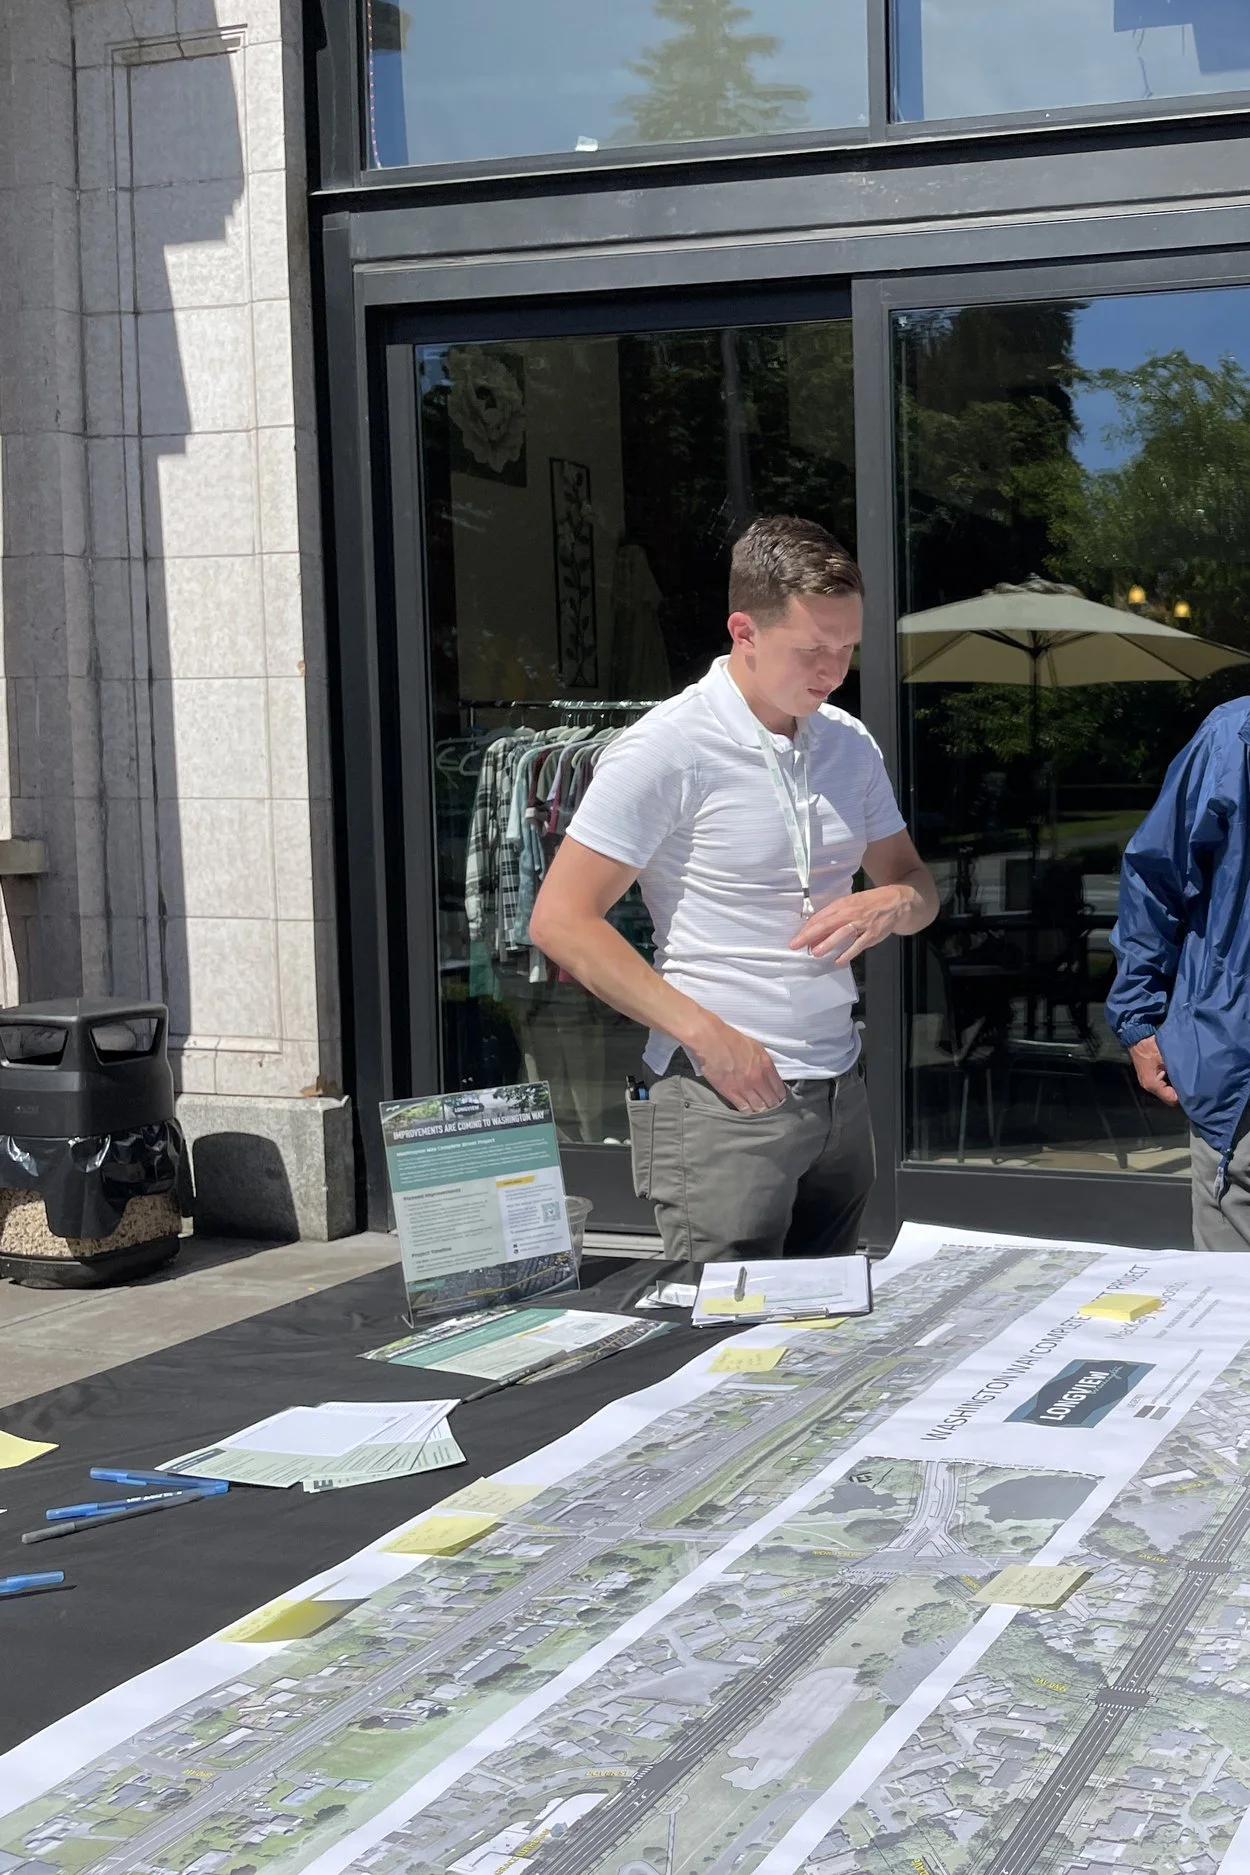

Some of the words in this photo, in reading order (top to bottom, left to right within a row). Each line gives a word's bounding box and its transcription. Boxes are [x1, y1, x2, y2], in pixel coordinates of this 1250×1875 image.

[393, 1125, 443, 1140] IMPROVEMENTS
[444, 1123, 457, 1132] ARE
[457, 1118, 482, 1131] COMING
[483, 1118, 491, 1127] TO
[492, 1113, 531, 1126] WASHINGTON
[532, 1110, 545, 1120] WAY
[921, 1371, 1019, 1441] WASHINGTON
[1004, 1355, 1043, 1376] WAY
[1029, 1311, 1092, 1354] COMPLETE
[1106, 1264, 1151, 1289] PROJECT
[1039, 1371, 1110, 1421] LONGVIEW
